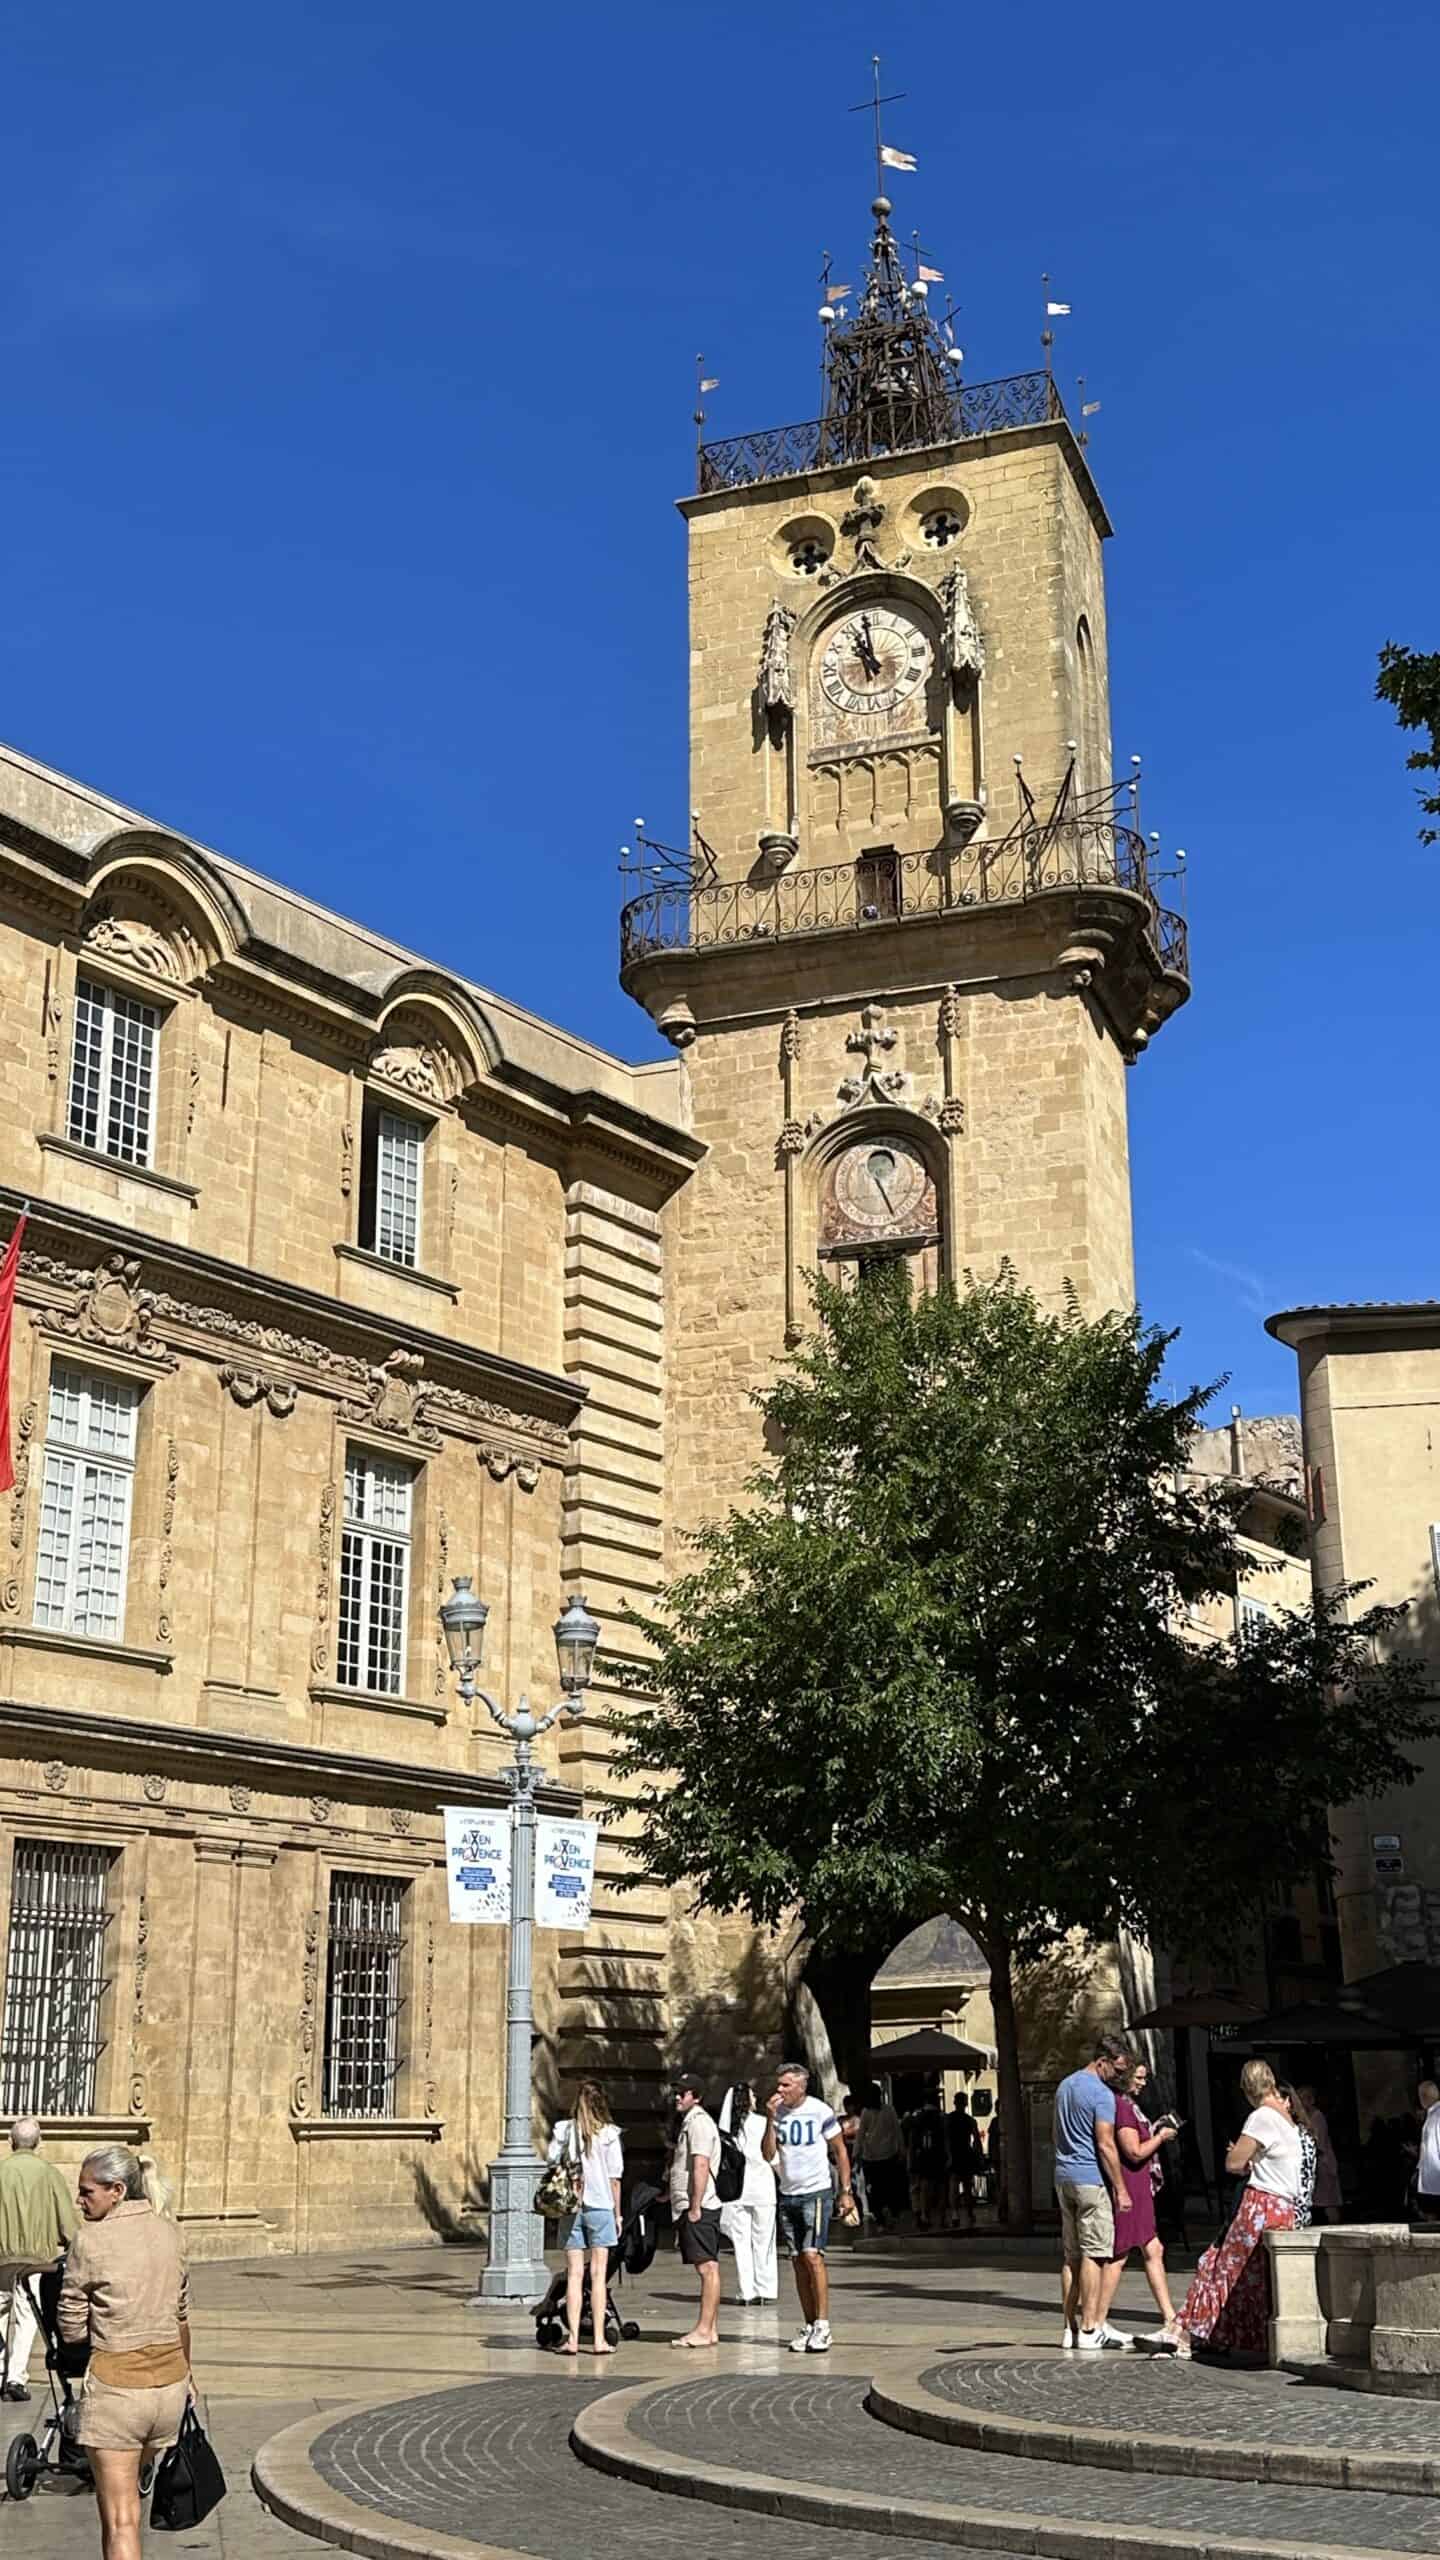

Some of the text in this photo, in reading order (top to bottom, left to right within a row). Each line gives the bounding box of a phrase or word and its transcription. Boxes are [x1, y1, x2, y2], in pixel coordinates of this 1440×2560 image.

[828, 642, 841, 655] X
[911, 646, 926, 658] III
[451, 1847, 503, 1862] PROVENCE
[544, 1855, 592, 1871] PROVENCE
[777, 2119, 816, 2146] 501
